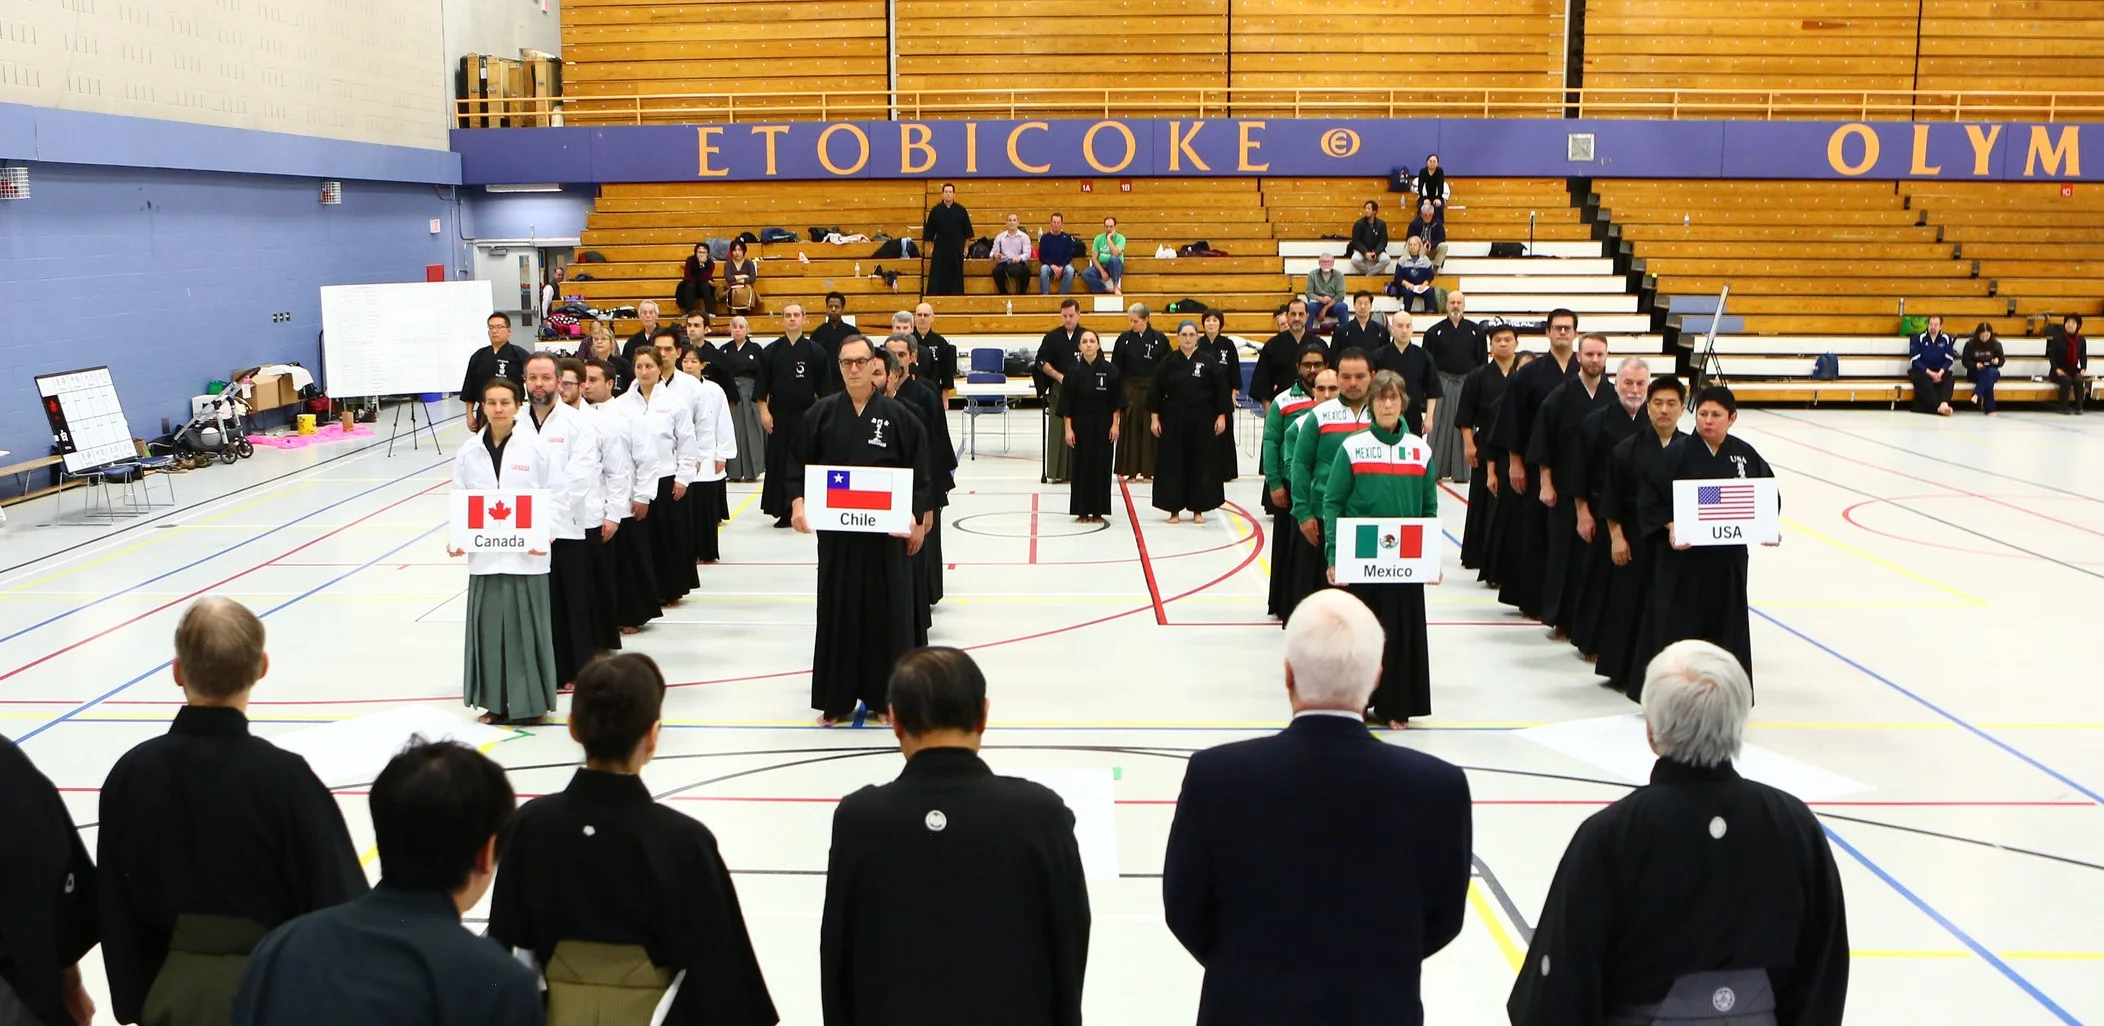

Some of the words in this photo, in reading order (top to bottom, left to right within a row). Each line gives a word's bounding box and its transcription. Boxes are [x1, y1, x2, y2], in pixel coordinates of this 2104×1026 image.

[697, 121, 1270, 177] ETOBICOKE
[1827, 123, 2081, 178] OLYM
[1082, 184, 1091, 193] 1A
[1322, 409, 1347, 422] MEXICO
[1355, 446, 1382, 459] MEXICO
[840, 512, 876, 527] Chile
[1712, 525, 1743, 540] USA
[474, 534, 525, 548] Canada
[1363, 564, 1413, 578] Mexico
